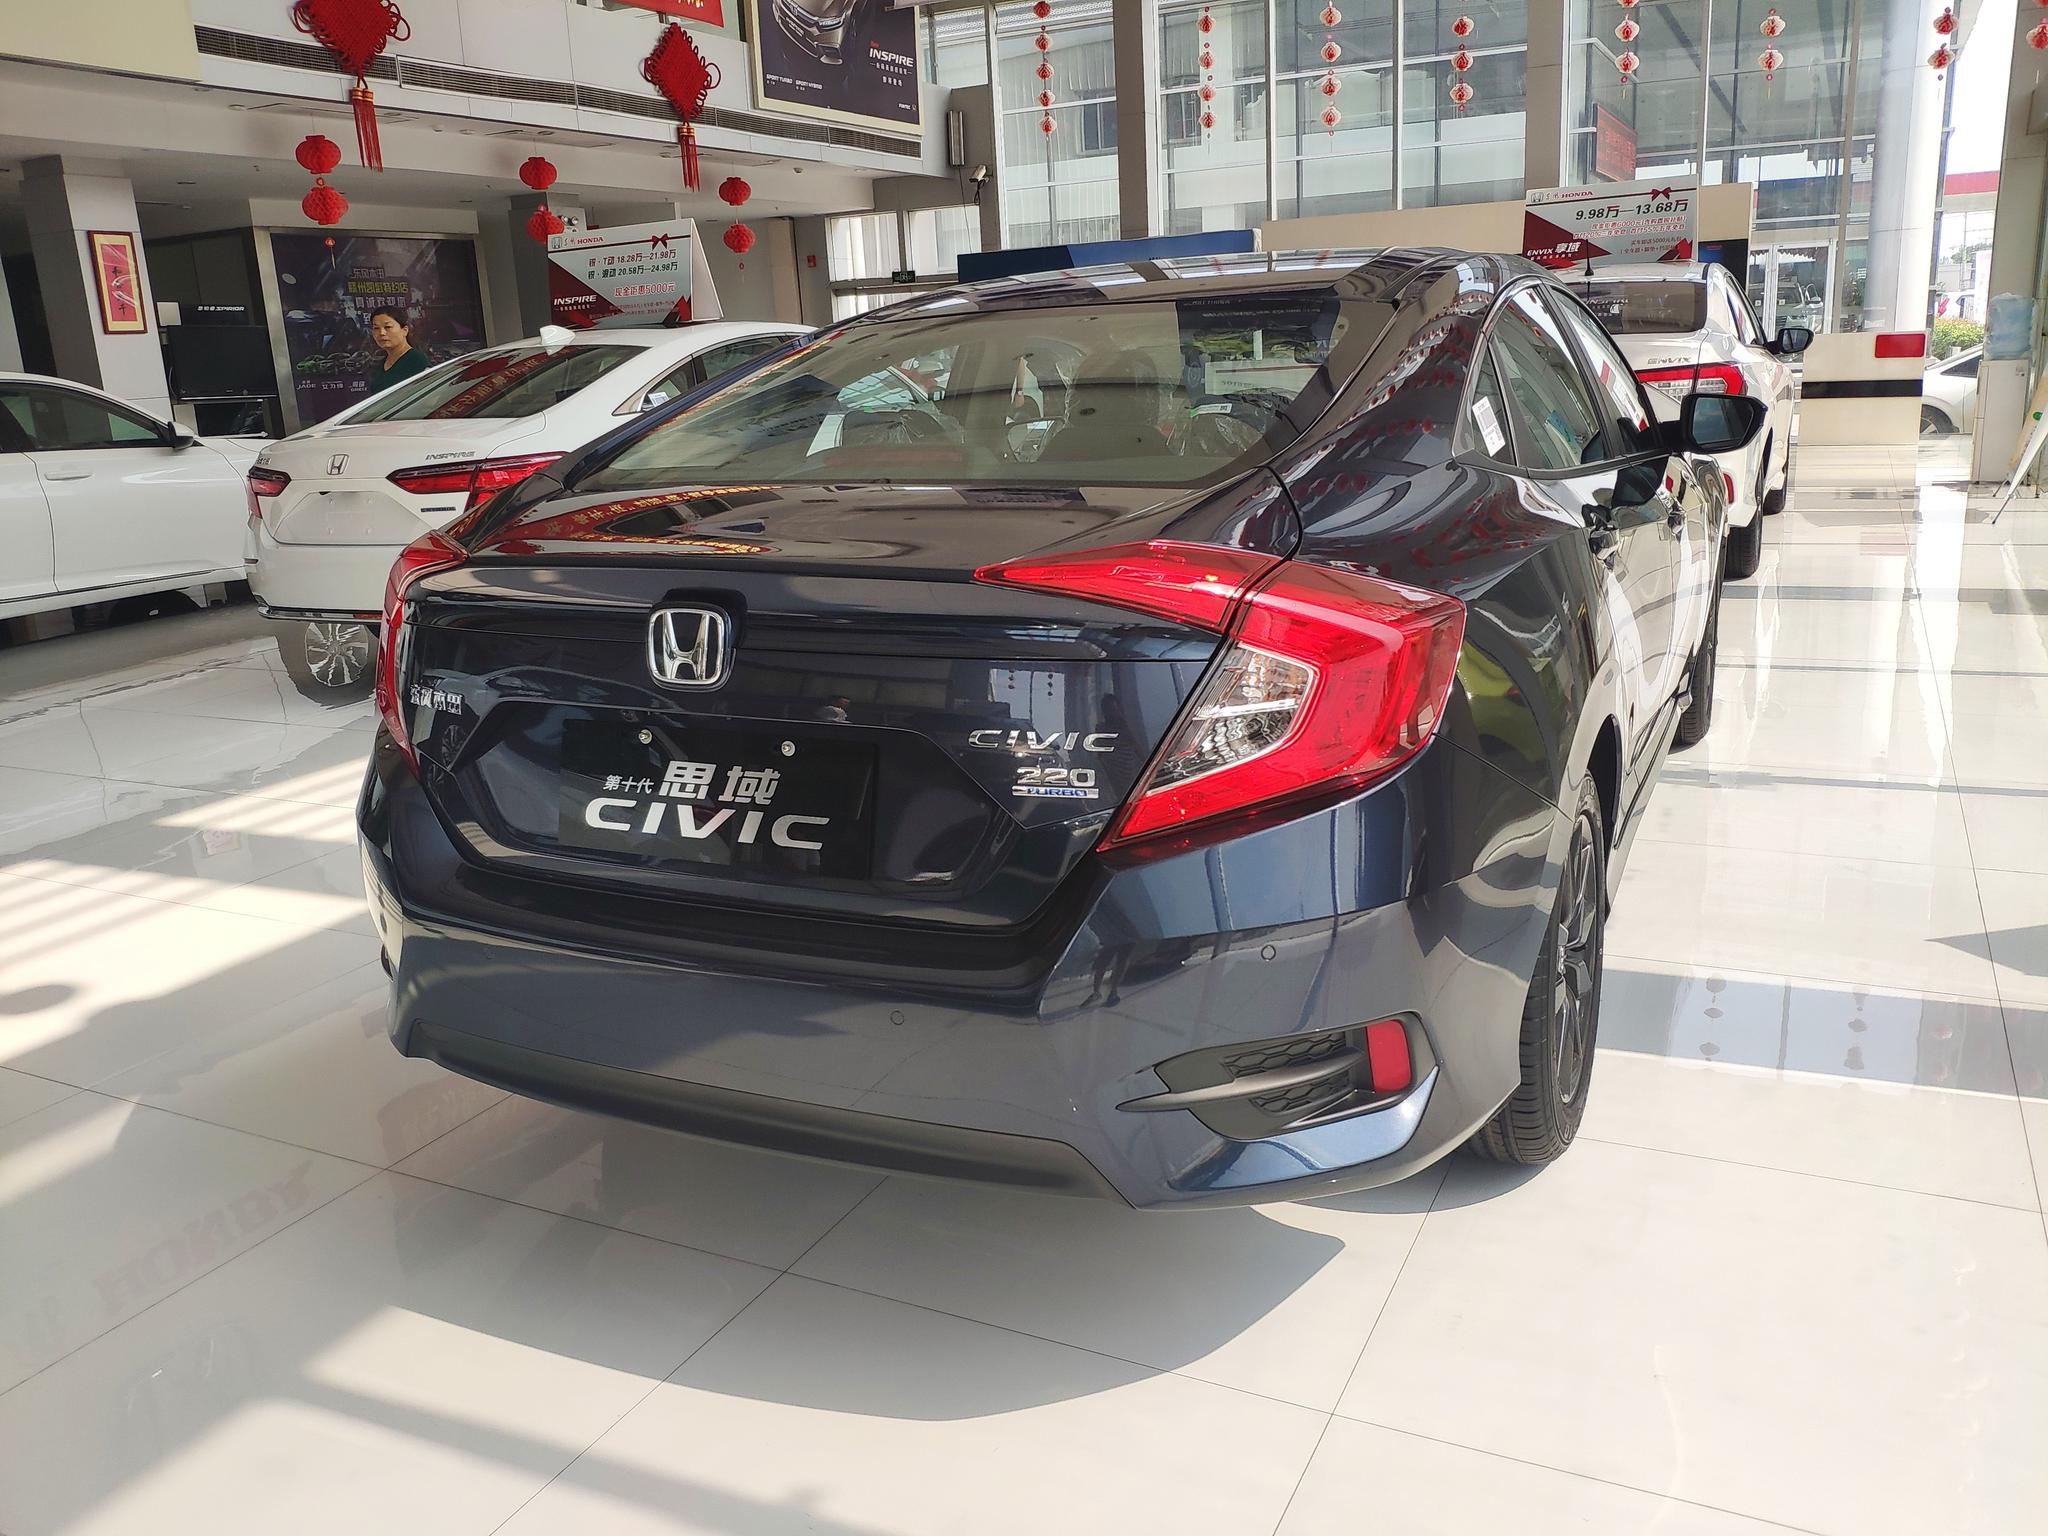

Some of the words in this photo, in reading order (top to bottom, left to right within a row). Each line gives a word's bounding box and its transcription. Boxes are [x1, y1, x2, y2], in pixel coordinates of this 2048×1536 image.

[869, 47, 914, 67] INSPIRE
[1561, 190, 1594, 199] HONDA
[1575, 199, 1689, 221] 9.98万—13.68万
[577, 236, 604, 246] HONDA
[617, 249, 676, 263] 18.28万—21.98万
[1527, 248, 1554, 257] ENVIX
[618, 262, 678, 276] 20.58万—24.98万
[553, 294, 597, 306] INSPIRE
[425, 451, 475, 460] INSPIRE
[968, 729, 1119, 752] CIVIC
[603, 774, 653, 795] 第十代
[659, 760, 781, 806] 思域
[1017, 766, 1096, 788] 220
[1022, 786, 1092, 798] TURBO
[585, 797, 830, 851] CIVIC
